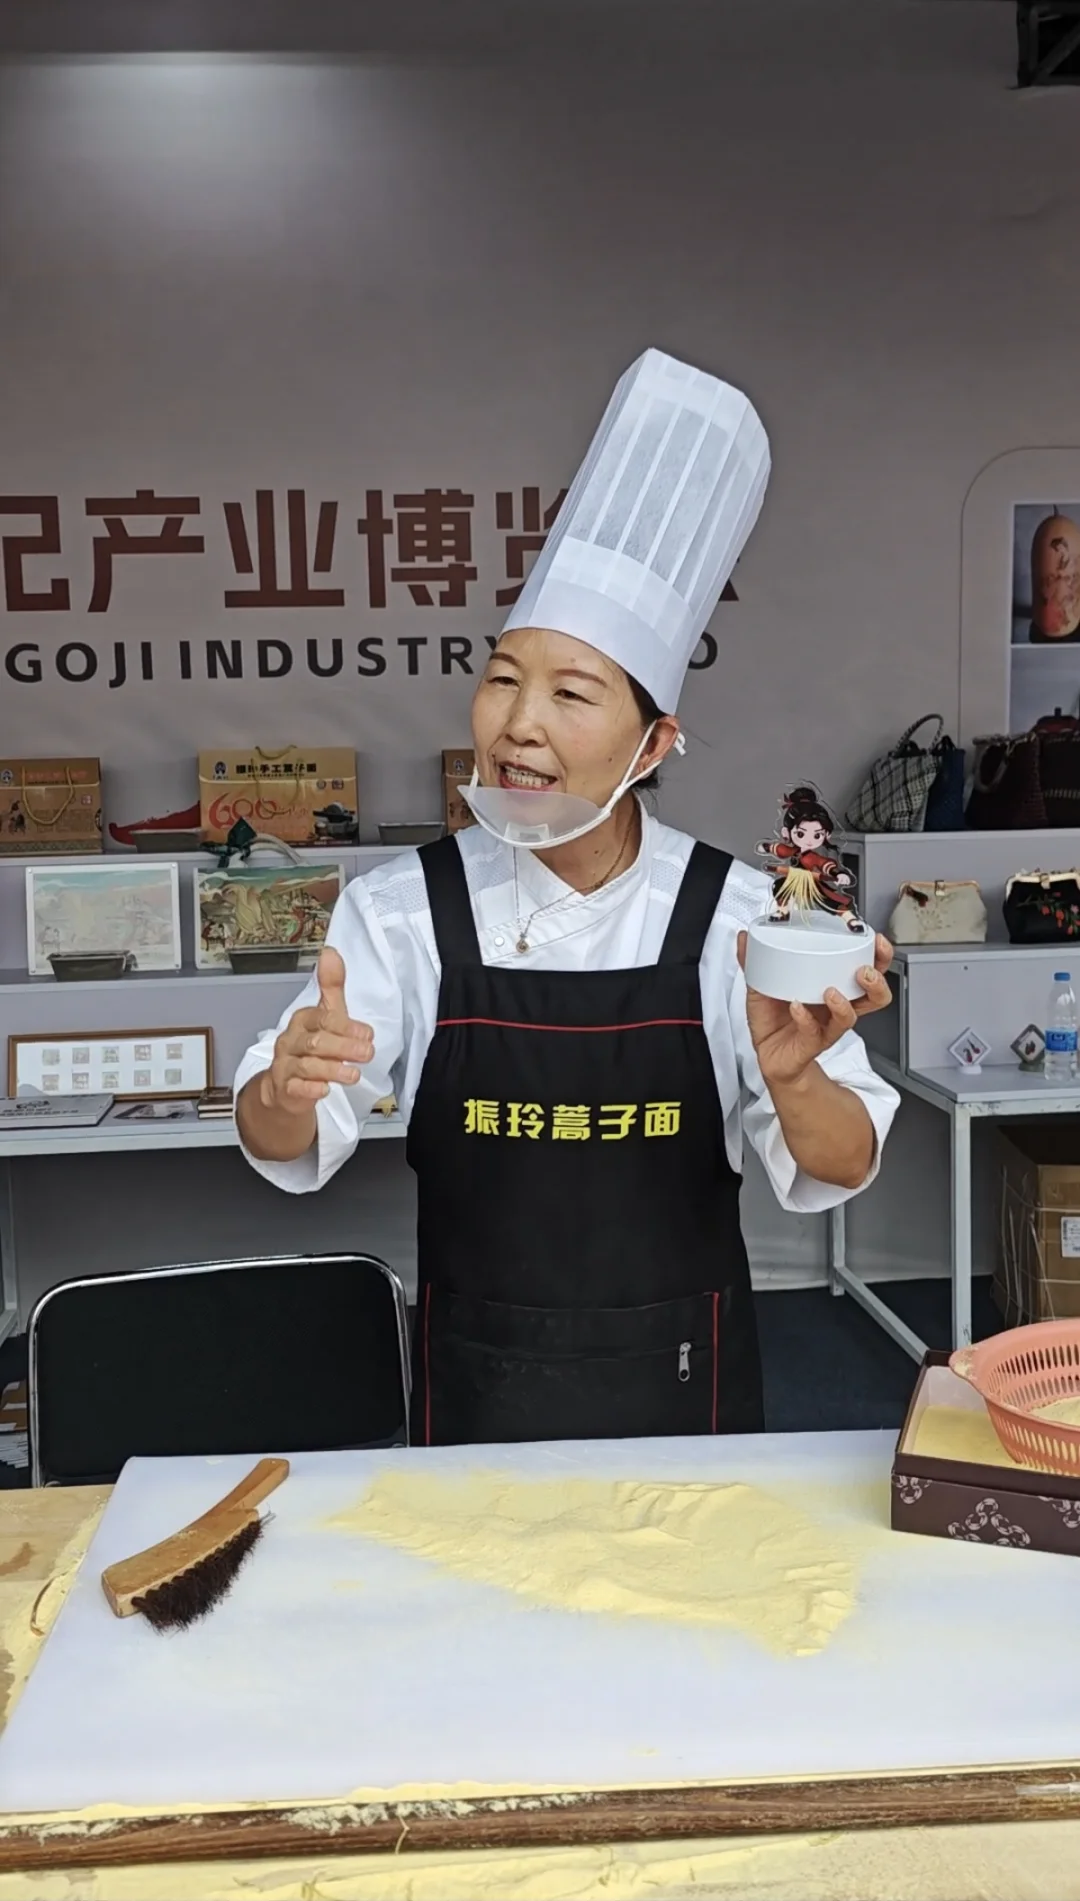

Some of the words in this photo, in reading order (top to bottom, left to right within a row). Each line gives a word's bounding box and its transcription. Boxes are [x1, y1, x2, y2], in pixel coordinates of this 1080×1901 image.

[0, 488, 740, 613] 产业博
[4, 641, 154, 689] GOJI
[179, 636, 499, 680] INDUSTR
[463, 1098, 682, 1140] 振玲蒿子面
